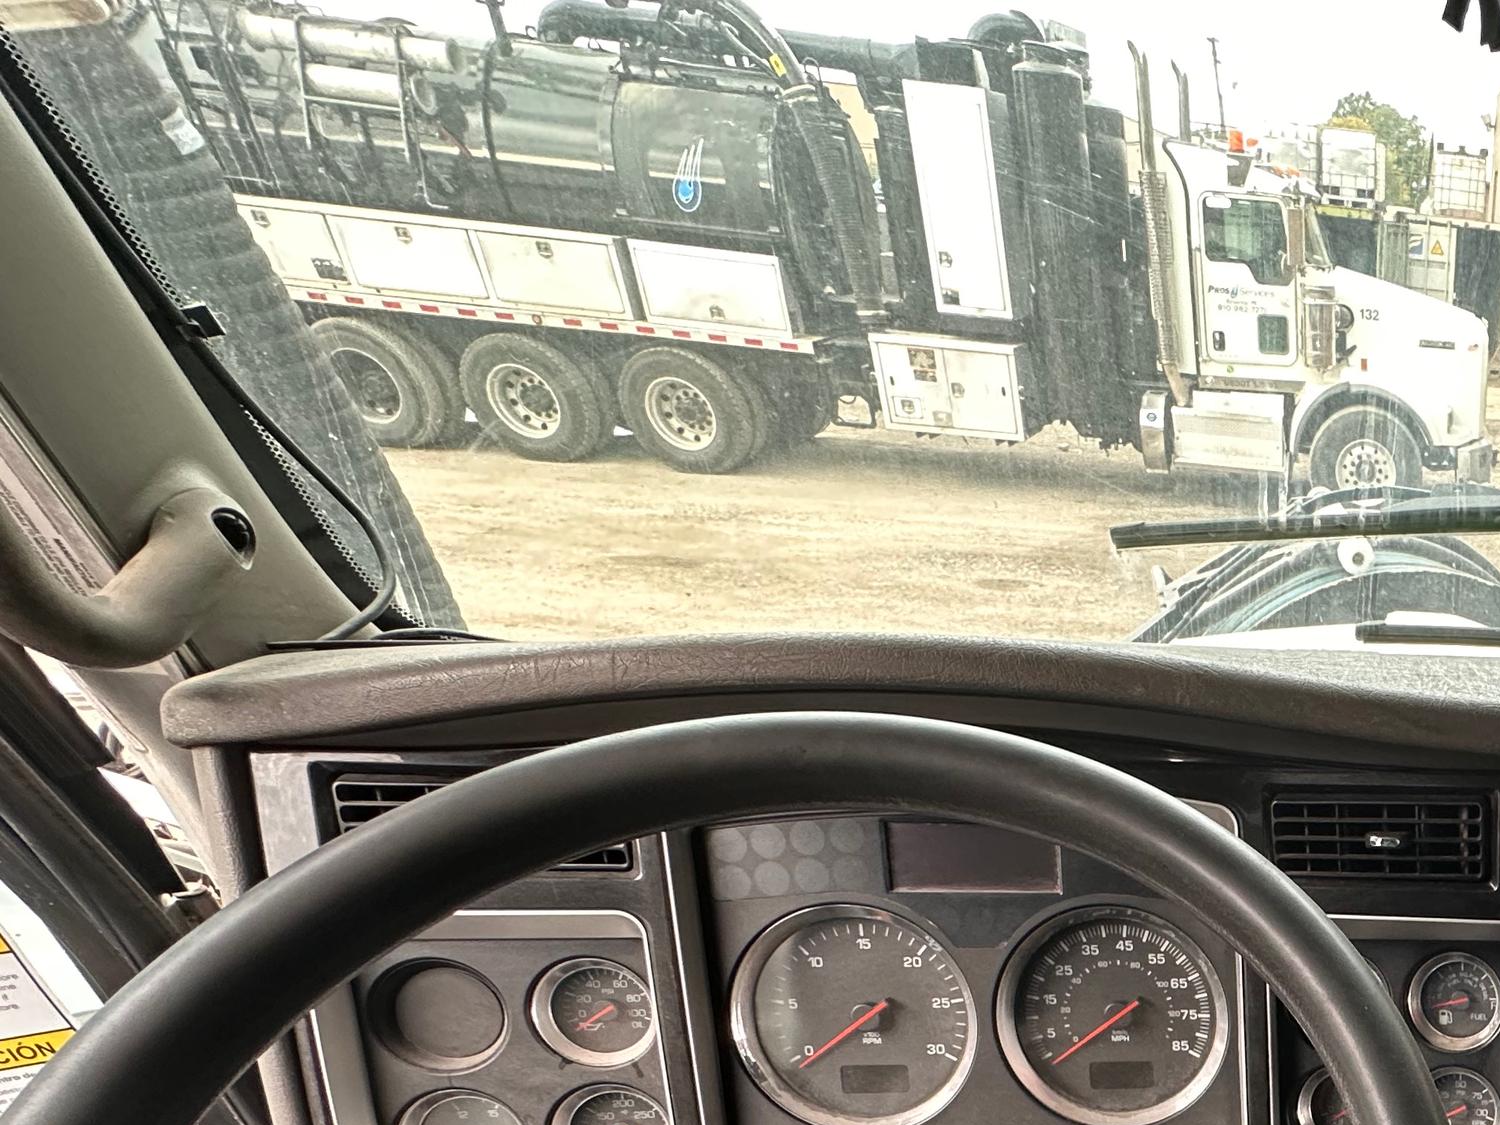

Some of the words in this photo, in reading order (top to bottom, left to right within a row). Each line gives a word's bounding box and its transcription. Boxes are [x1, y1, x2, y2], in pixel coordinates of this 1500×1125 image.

[1359, 309, 1380, 321] 132
[856, 939, 871, 950] 15
[1115, 940, 1134, 951] 45
[1081, 945, 1099, 955] 35
[808, 957, 824, 967] 10
[903, 957, 922, 967] 20
[1148, 954, 1165, 964] 55
[1055, 965, 1073, 976] 25
[585, 980, 600, 988] 40
[613, 980, 628, 988] 60
[1170, 978, 1188, 989] 65
[576, 994, 592, 1003] 20
[626, 994, 641, 1003] 80
[932, 998, 950, 1009] 25
[1043, 994, 1057, 1005] 15
[788, 999, 798, 1010] 5
[1181, 1010, 1198, 1020] 75
[1047, 1028, 1056, 1039] 5
[804, 1046, 814, 1056] 0
[926, 1044, 945, 1055] 30
[1172, 1041, 1189, 1051] 85
[612, 1099, 635, 1108] 200
[633, 1111, 655, 1119] 250
